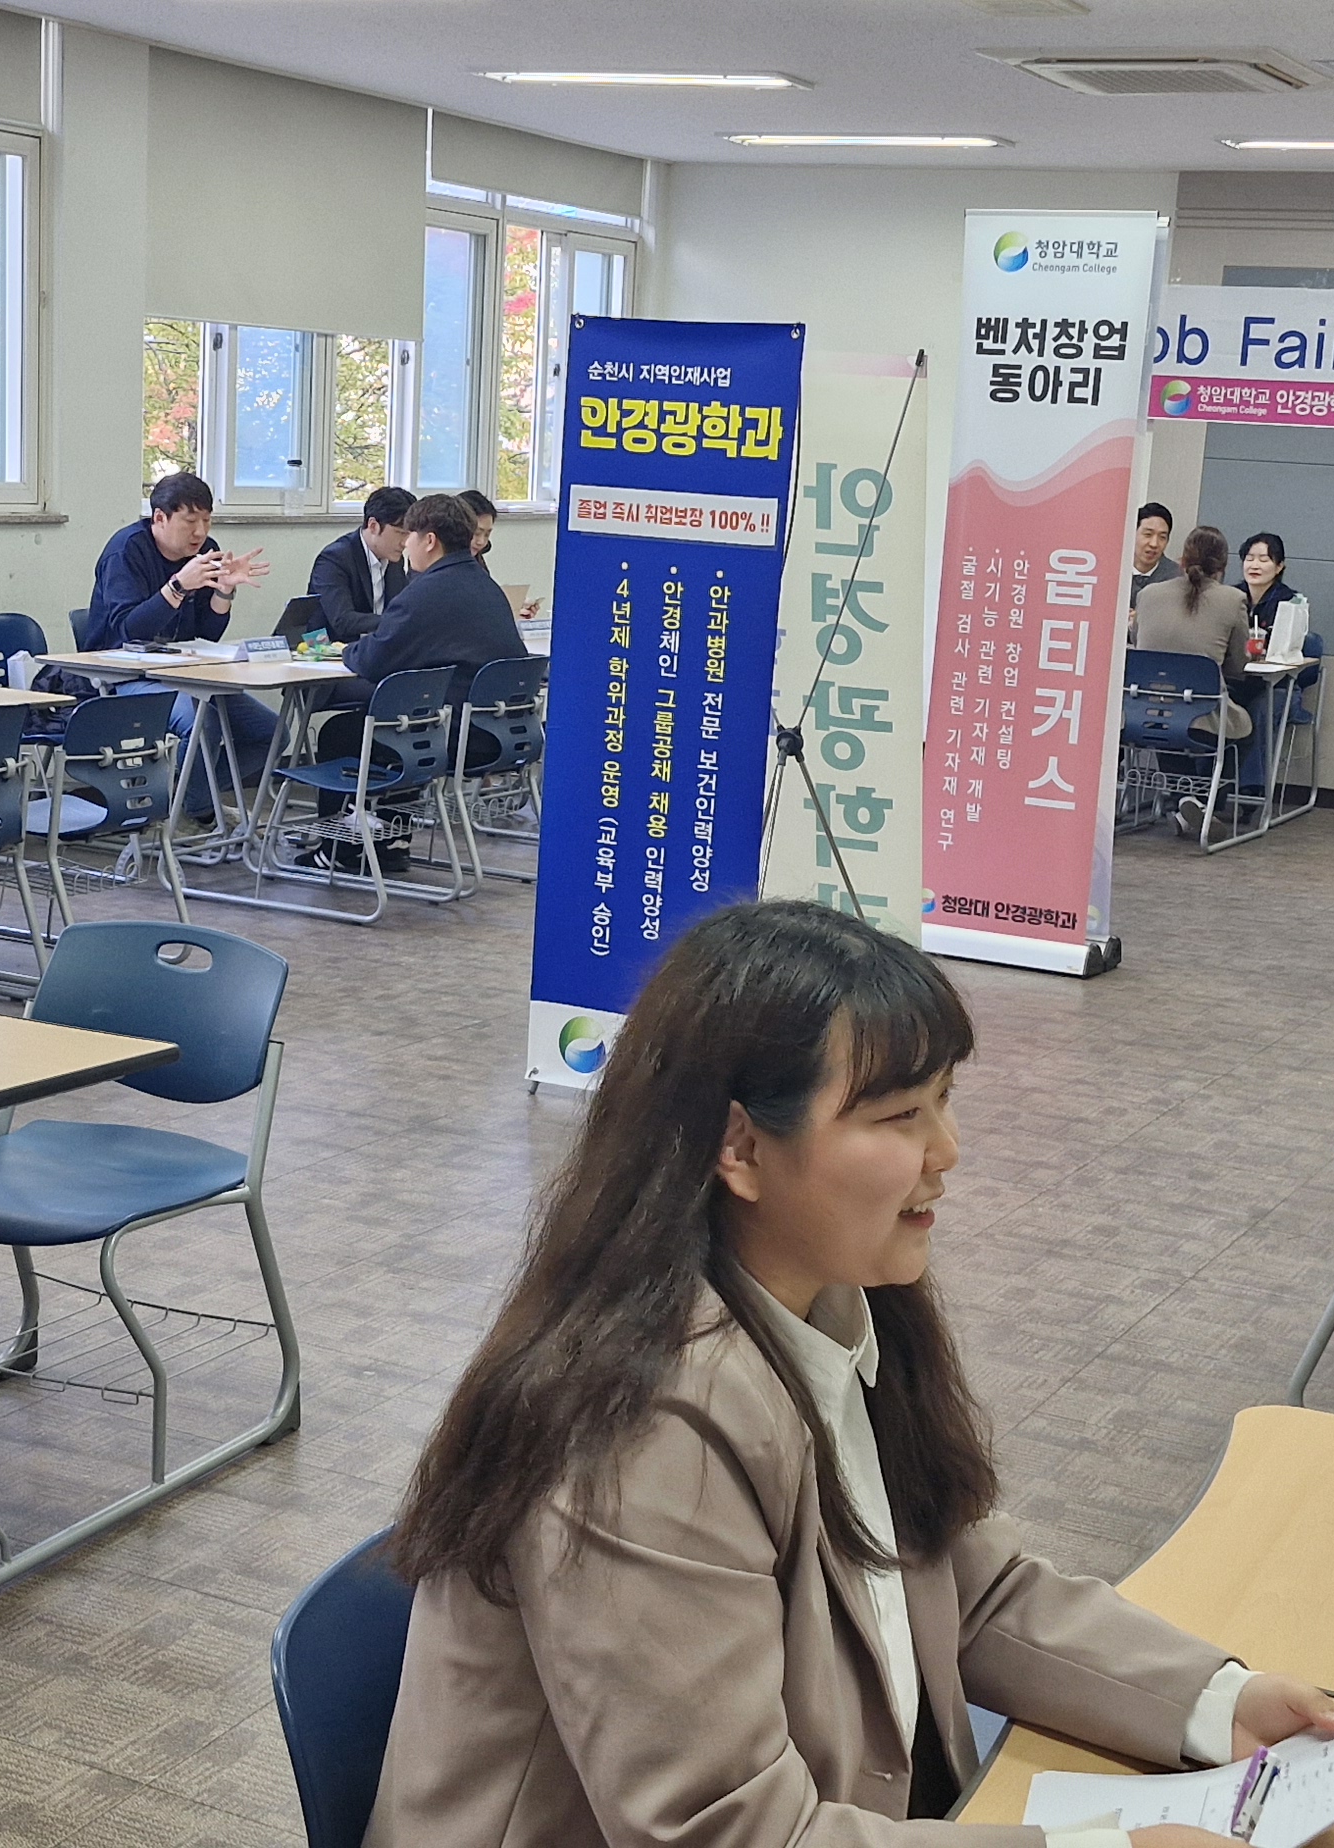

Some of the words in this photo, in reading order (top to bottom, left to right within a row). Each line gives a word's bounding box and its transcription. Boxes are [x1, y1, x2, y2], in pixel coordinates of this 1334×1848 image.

[1032, 262, 1080, 274] Cheongam
[1082, 263, 1118, 274] College
[1034, 240, 1119, 259] 청암대학교
[975, 317, 1129, 361] 벤처창업
[587, 360, 634, 382] 순천시
[639, 363, 732, 387] 지역인재사업
[989, 363, 1103, 406] 동아리
[1197, 385, 1271, 405] 청암대학교
[580, 396, 784, 460] 안경광학과
[577, 499, 607, 520] 졸업
[611, 502, 640, 523] 즉시
[644, 504, 704, 528] 취업보장
[708, 510, 756, 532] 100%
[960, 556, 978, 602] 굴절
[982, 557, 1004, 627] 시기능
[1008, 559, 1030, 630] 안경원
[609, 578, 632, 649] 4년제
[658, 581, 685, 679] 안경체인
[704, 585, 731, 683] 안과병원
[954, 614, 972, 659] 검사
[977, 640, 997, 686] 관련
[1003, 642, 1022, 687] 창업
[1024, 548, 1098, 811] 옵티커스
[602, 655, 630, 753] 학위과정
[699, 691, 724, 741] 전문
[949, 671, 968, 716] 관련
[650, 688, 677, 783] 그룹공채
[970, 698, 991, 768] 기자재
[996, 700, 1016, 770] 컨설팅
[599, 759, 623, 809] 운영
[942, 728, 962, 797] 기자재
[646, 791, 670, 839] 채용
[688, 749, 721, 893] 보건인력양성
[965, 779, 983, 823] 개발
[593, 817, 619, 893] (교육부
[937, 809, 955, 852] 연구
[639, 846, 667, 941] 인력양성
[941, 894, 990, 918] 청암대
[994, 901, 1078, 930] 안경광학과
[590, 901, 613, 956] 승인)
